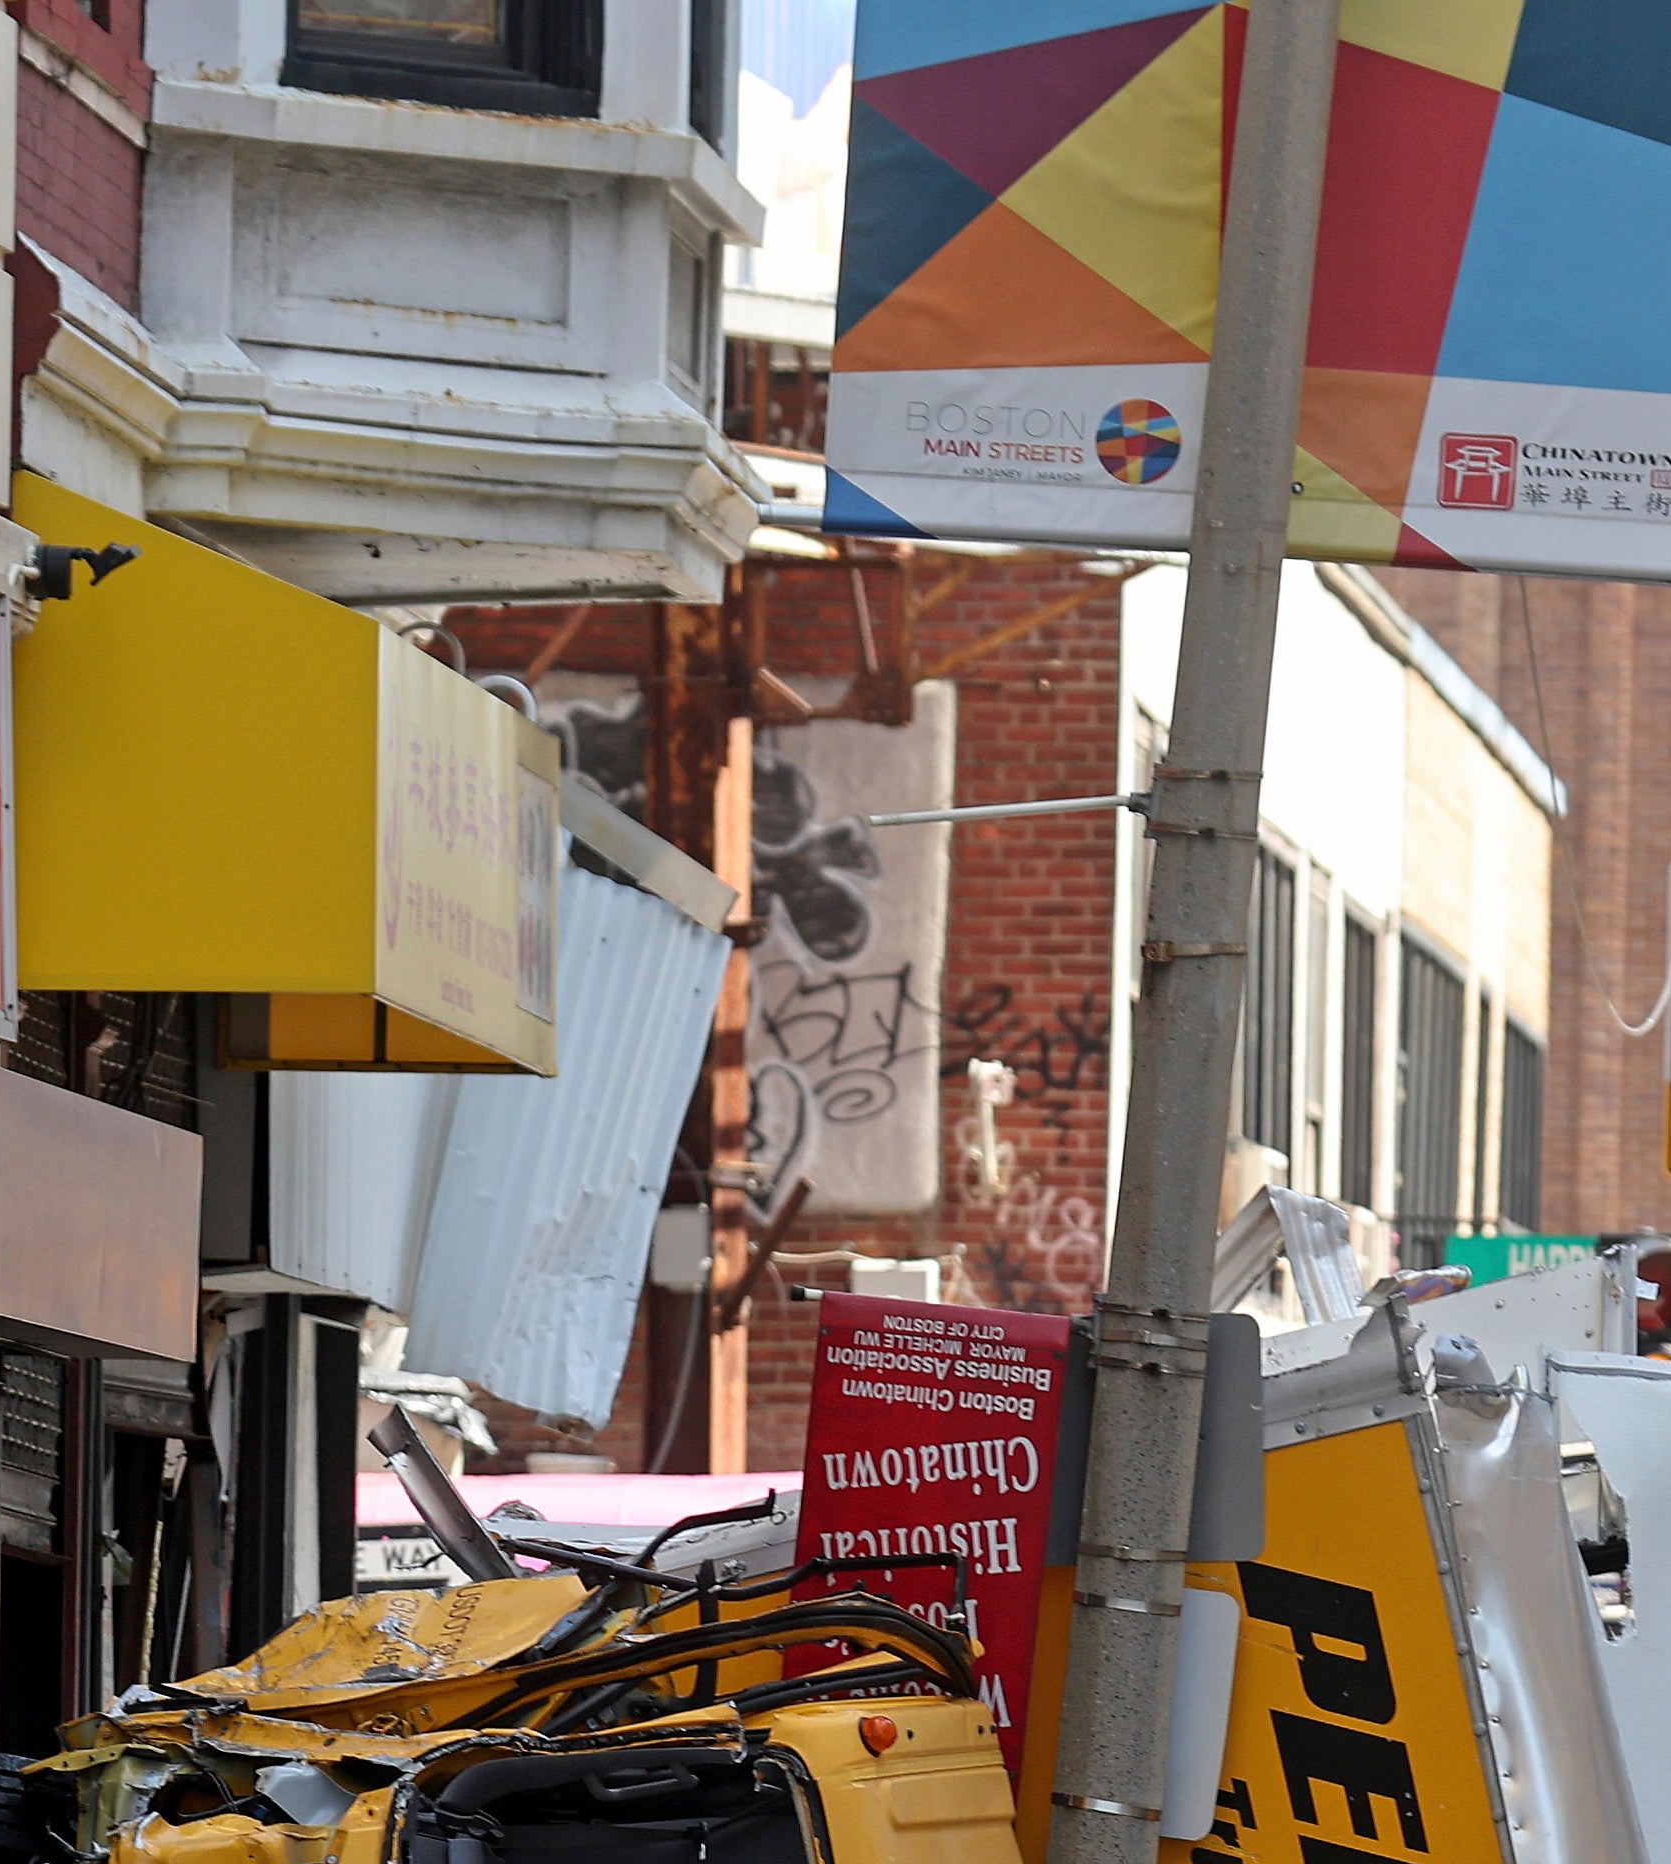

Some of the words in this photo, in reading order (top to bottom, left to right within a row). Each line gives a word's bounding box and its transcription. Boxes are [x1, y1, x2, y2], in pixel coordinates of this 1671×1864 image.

[905, 401, 1086, 440] BOSTON
[923, 438, 981, 458] MAIN
[988, 441, 1084, 465] STREETS
[1036, 471, 1083, 483] MAYOR
[1523, 465, 1573, 479] MAIN
[1579, 468, 1645, 484] STREET
[883, 1314, 945, 1336] BOSTON
[947, 1320, 969, 1338] OF
[970, 1326, 1005, 1342] CITY
[852, 1329, 881, 1348] WU
[883, 1332, 963, 1357] MICHELLE
[969, 1340, 1026, 1363] MAYOR
[826, 1344, 951, 1381] Association
[953, 1358, 1053, 1392] Business
[840, 1377, 955, 1413] Chinatown
[958, 1388, 1037, 1422] Boston
[823, 1435, 1041, 1495] Chinatown
[818, 1517, 1024, 1584] Historical
